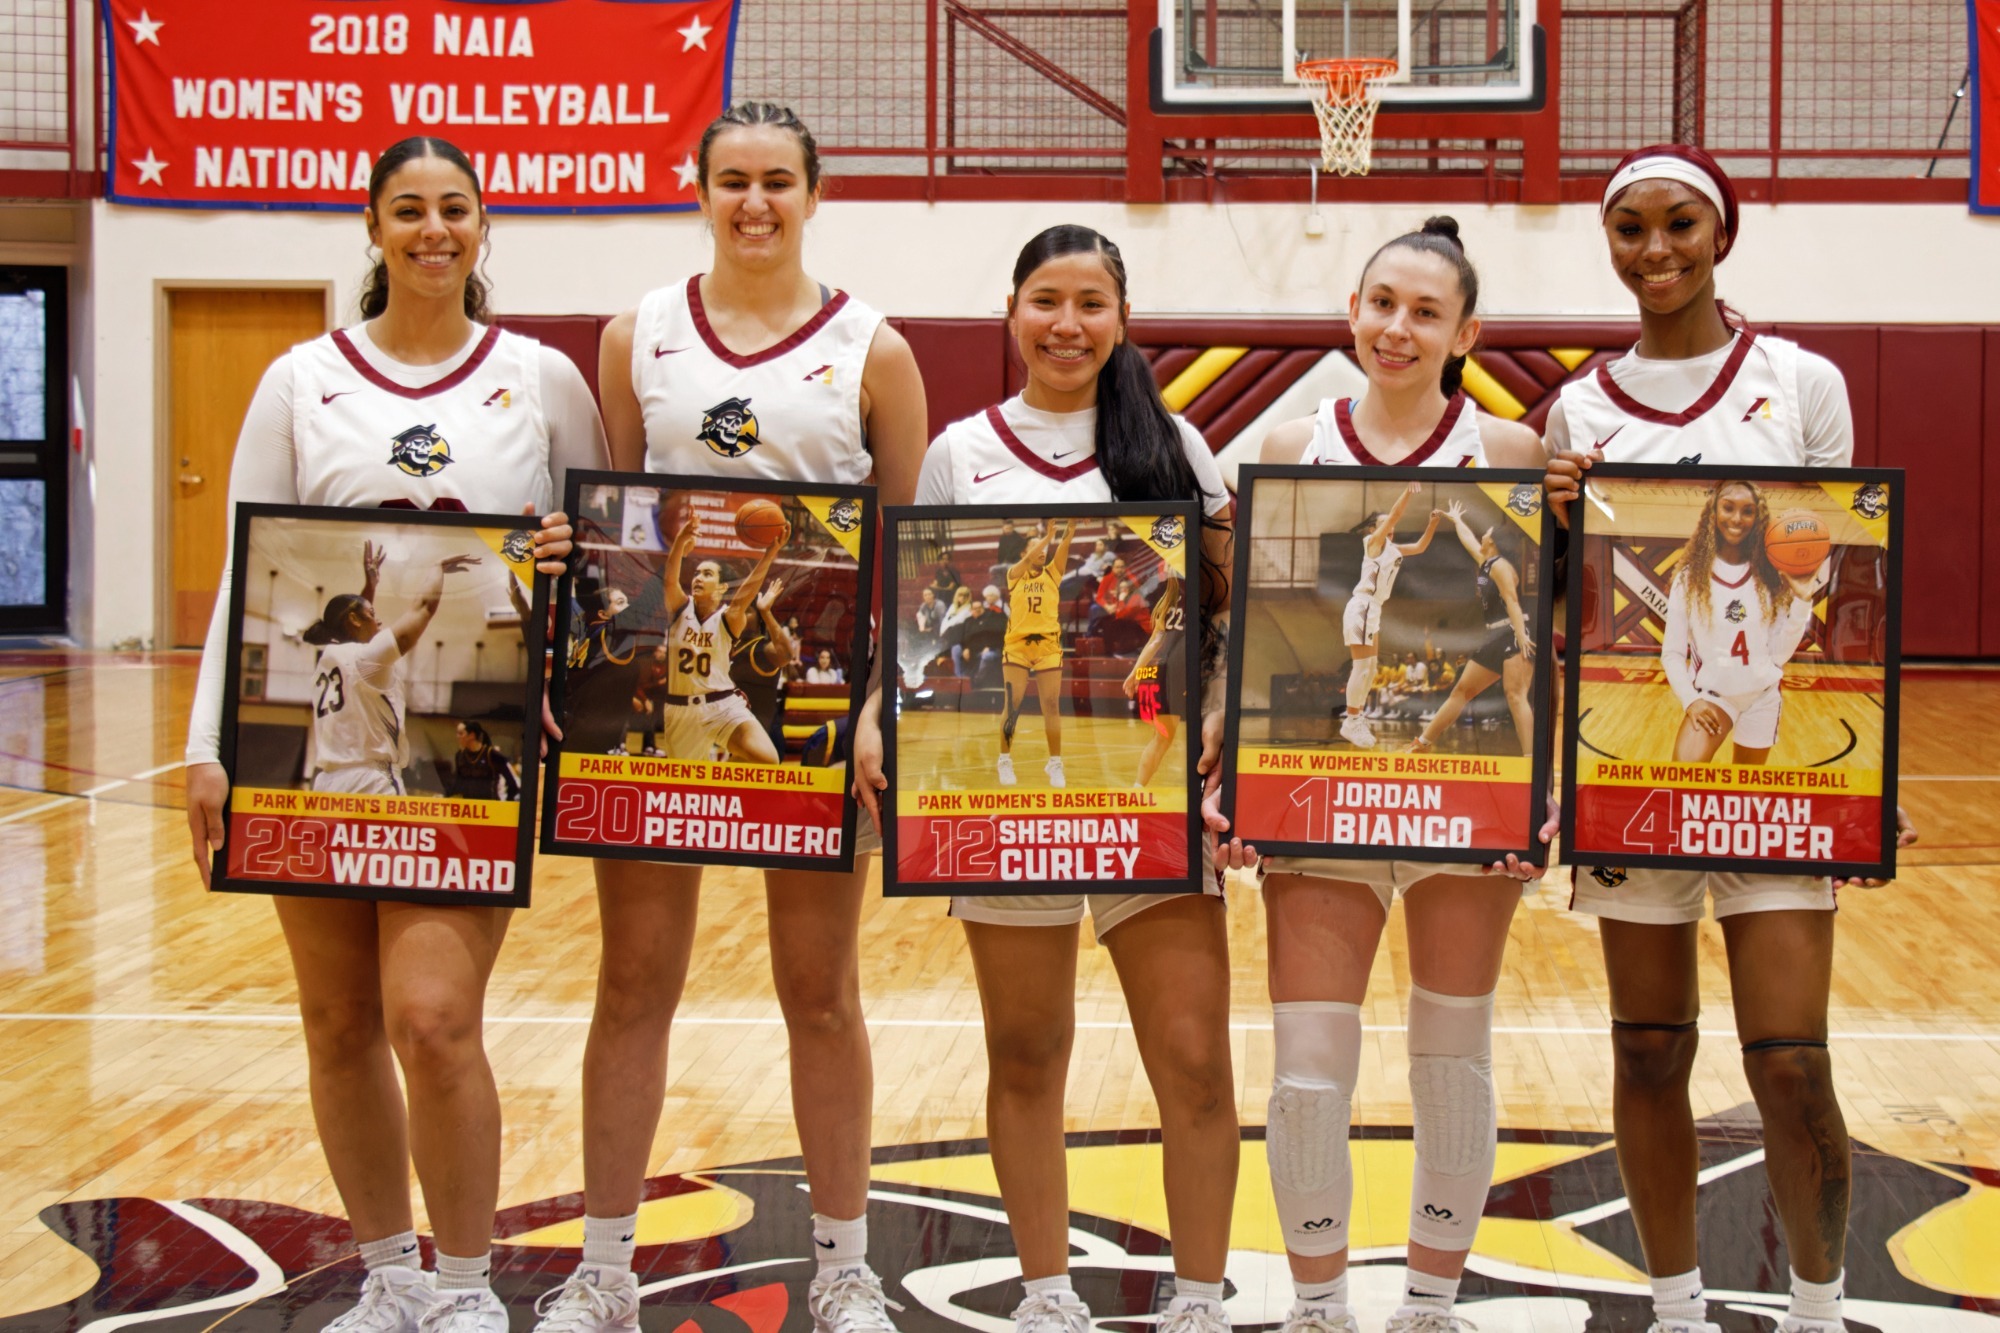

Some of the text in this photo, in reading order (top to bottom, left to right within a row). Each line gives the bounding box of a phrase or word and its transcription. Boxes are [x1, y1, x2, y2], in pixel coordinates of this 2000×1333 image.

[309, 14, 535, 58] 2018 NAIA
[172, 77, 670, 126] WOMEN'S VOLLEYBALL
[195, 147, 372, 191] NATIONA
[1024, 581, 1045, 593] PARK
[1028, 596, 1042, 614] 12
[1165, 607, 1184, 630] 22
[682, 626, 714, 648] PARK
[1731, 630, 1749, 666] 4
[678, 647, 711, 678] 20
[316, 666, 345, 718] 23
[580, 758, 813, 785] PARK WOMEN'S BASKETBALL
[1259, 753, 1501, 775] PARK WOMEN'S BASKETBALL
[1597, 764, 1849, 788] PARK WOMEN'S BASKETBALL
[253, 793, 489, 819] PARK WOMEN'S BASKETBALL
[646, 791, 743, 818] MARINA
[918, 792, 1157, 810] PARK WOMEN'S BASKETBALL
[1290, 777, 1329, 842] 1
[1333, 782, 1442, 810] JORDAN
[1681, 794, 1811, 824] NADIYAH
[555, 783, 640, 843] 20
[1623, 789, 1679, 855] 4
[331, 823, 436, 852] ALEXUS
[644, 817, 842, 856] PERDIGUERO
[1000, 818, 1139, 844] SHERIDAN
[1333, 812, 1472, 848] BIANCO
[1681, 821, 1832, 859] COOPER
[243, 817, 328, 877] 23
[931, 818, 997, 877] 12
[331, 852, 516, 892] WOODARD
[1000, 848, 1140, 880] CURLEY
